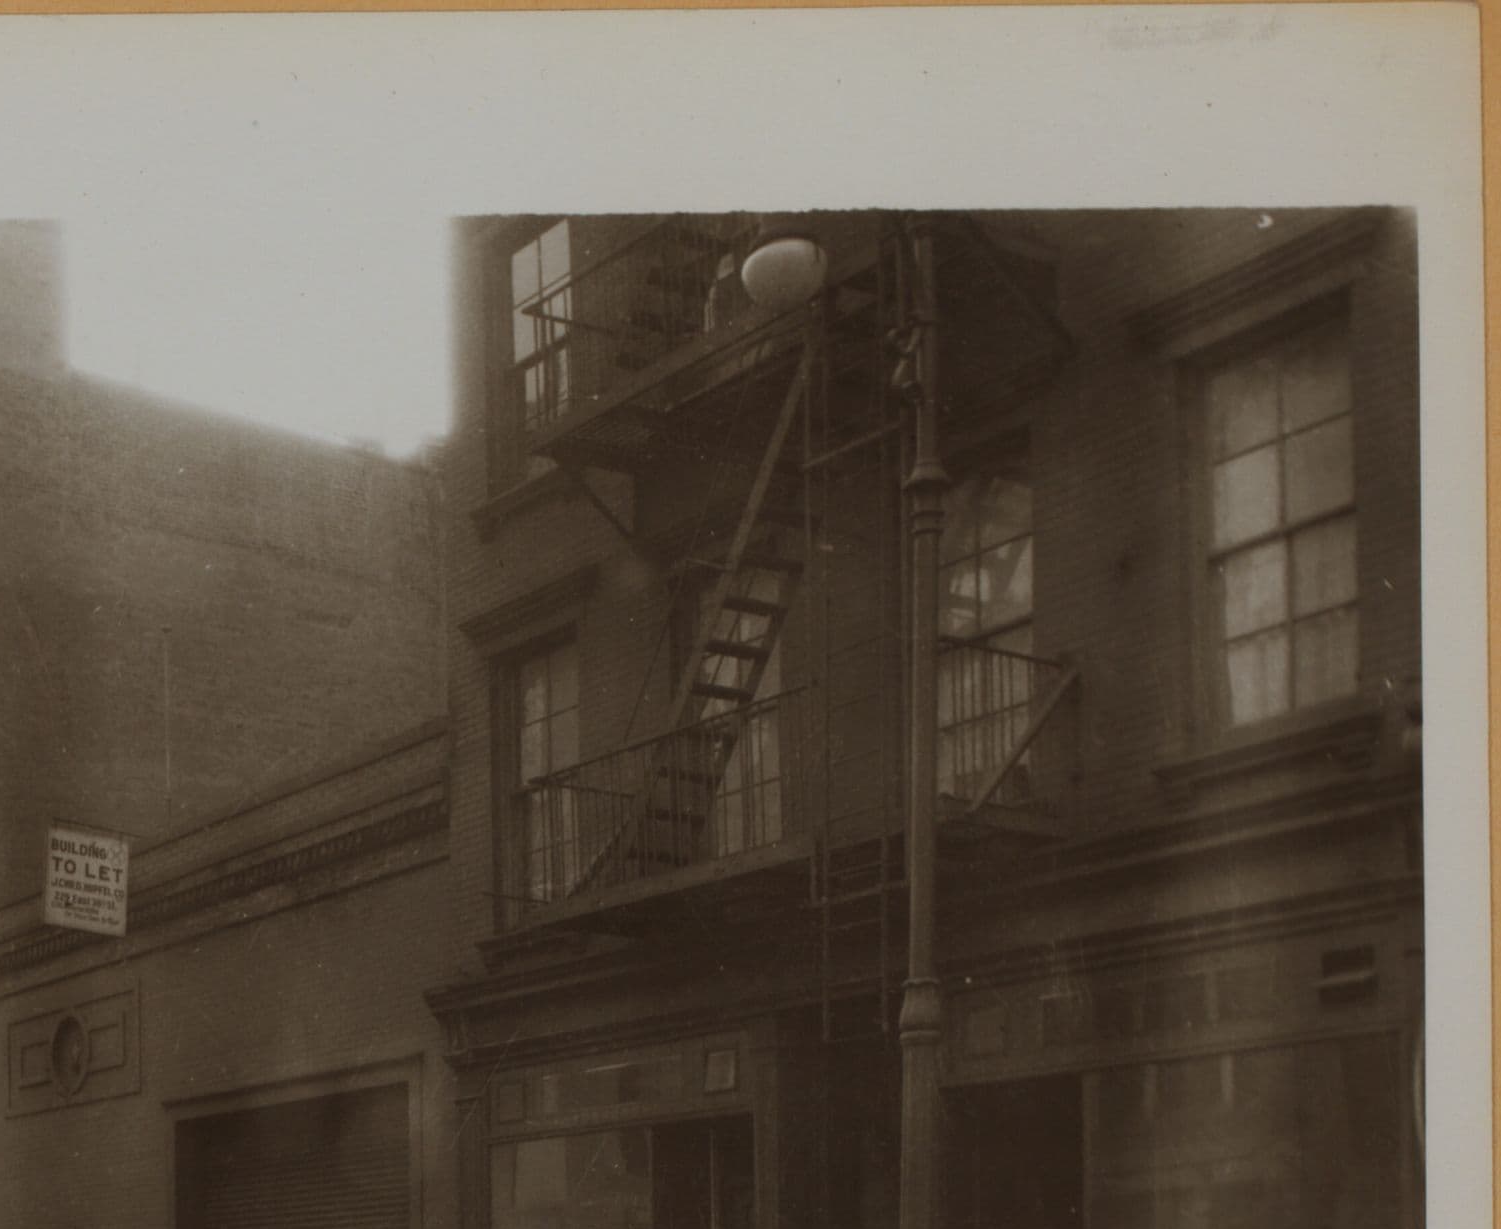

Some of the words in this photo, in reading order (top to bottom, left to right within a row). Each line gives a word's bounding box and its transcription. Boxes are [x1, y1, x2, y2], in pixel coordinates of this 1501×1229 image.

[51, 838, 108, 860] BUILDING
[51, 856, 77, 875] TO
[85, 863, 123, 883] LET
